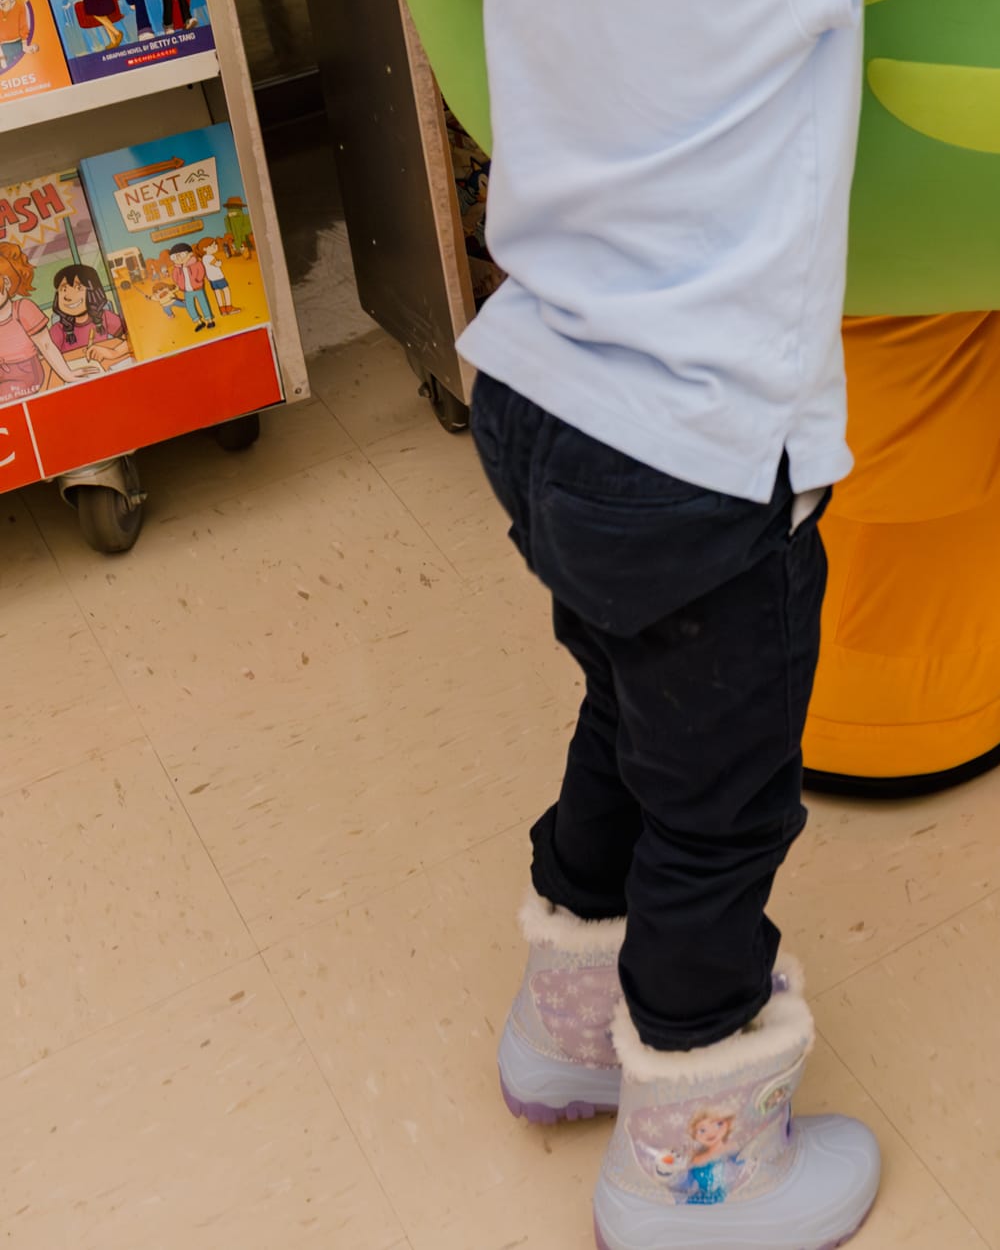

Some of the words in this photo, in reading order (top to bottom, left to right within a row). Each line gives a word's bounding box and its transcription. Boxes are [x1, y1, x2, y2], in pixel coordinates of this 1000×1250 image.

[149, 38, 171, 50] BETTY
[1, 73, 37, 90] SIDES
[124, 174, 181, 206] NEXT
[142, 184, 215, 222] STOP
[0, 183, 65, 239] ASH
